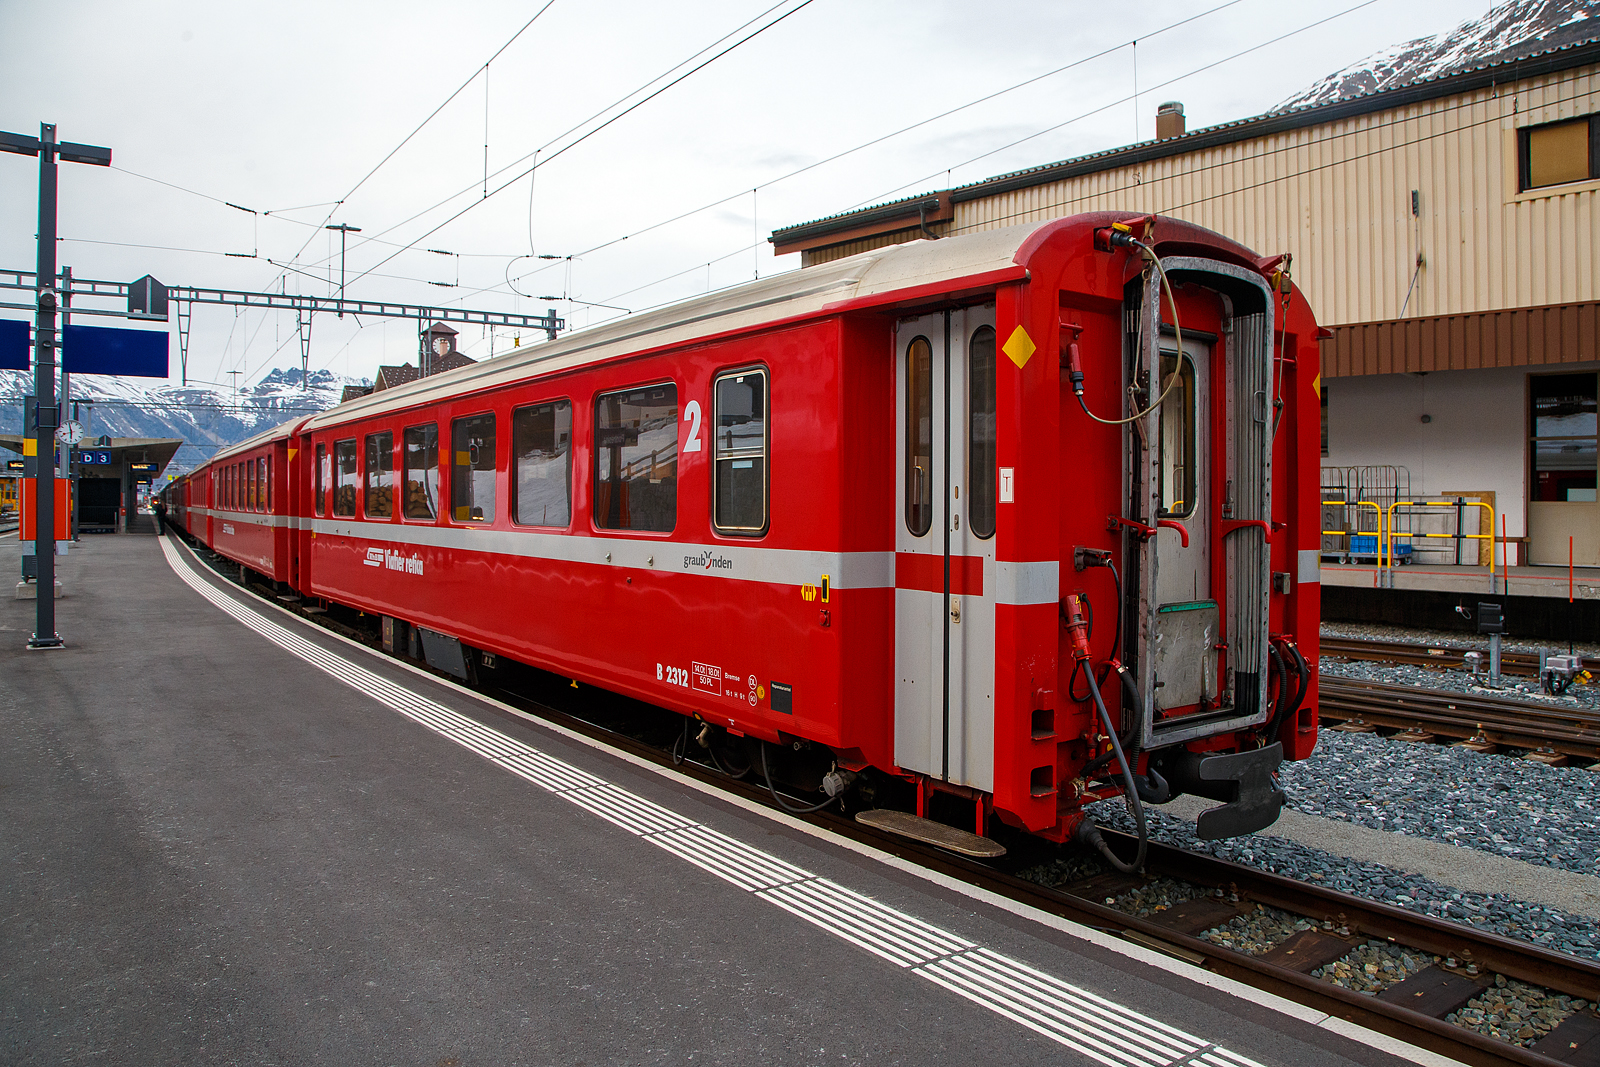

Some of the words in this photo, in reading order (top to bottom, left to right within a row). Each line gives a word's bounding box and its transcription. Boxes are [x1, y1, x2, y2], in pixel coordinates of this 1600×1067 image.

[683, 400, 702, 453] 2
[656, 663, 663, 680] B
[666, 665, 689, 687] 2312
[700, 675, 707, 685] 50
[724, 672, 741, 682] Bremse
